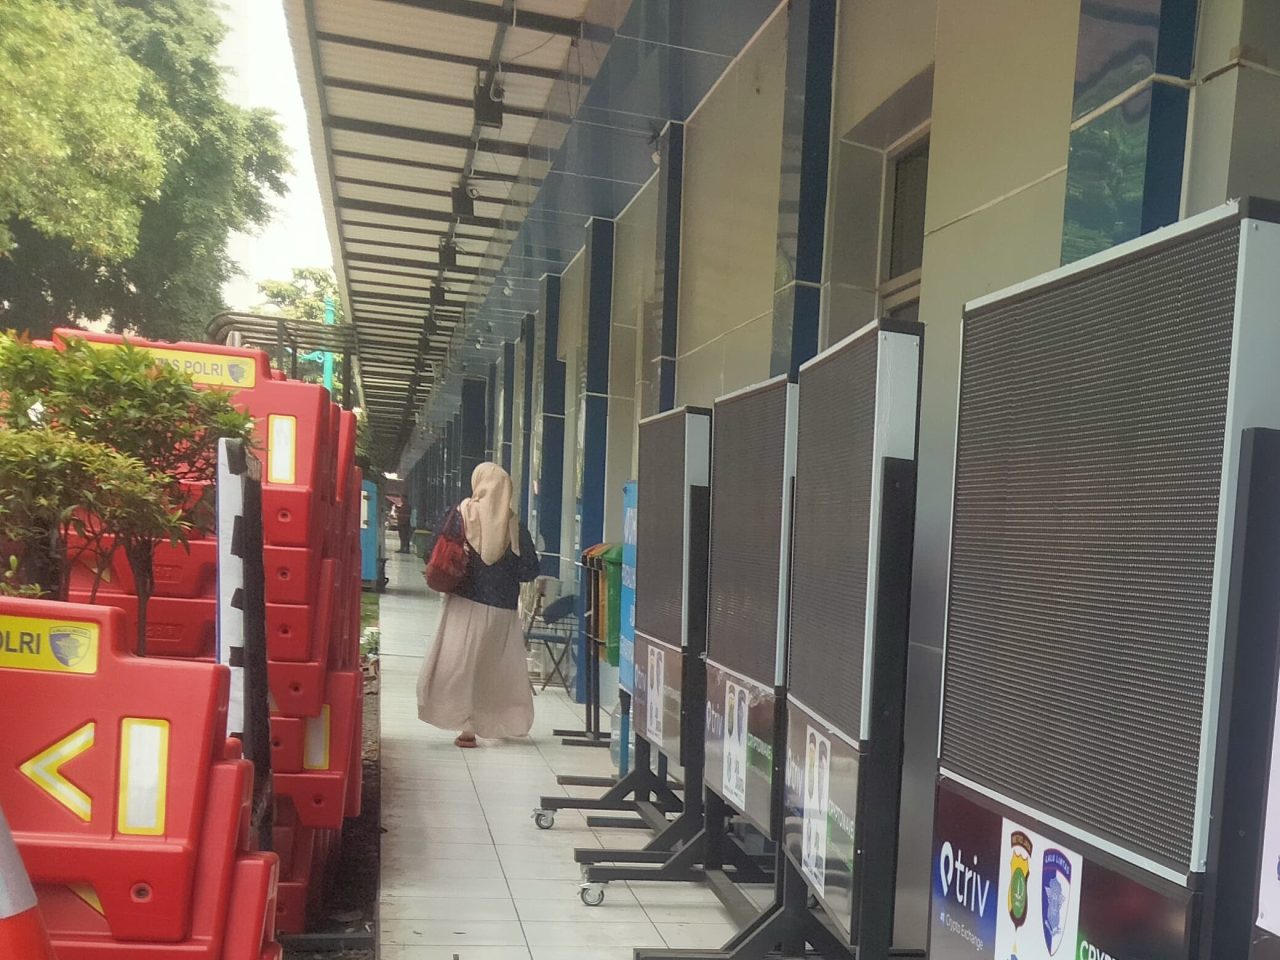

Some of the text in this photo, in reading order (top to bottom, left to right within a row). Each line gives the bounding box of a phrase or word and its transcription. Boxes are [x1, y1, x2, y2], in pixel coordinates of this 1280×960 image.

[184, 360, 223, 377] POLRI
[0, 630, 41, 655] LRI
[955, 849, 990, 918] triv
